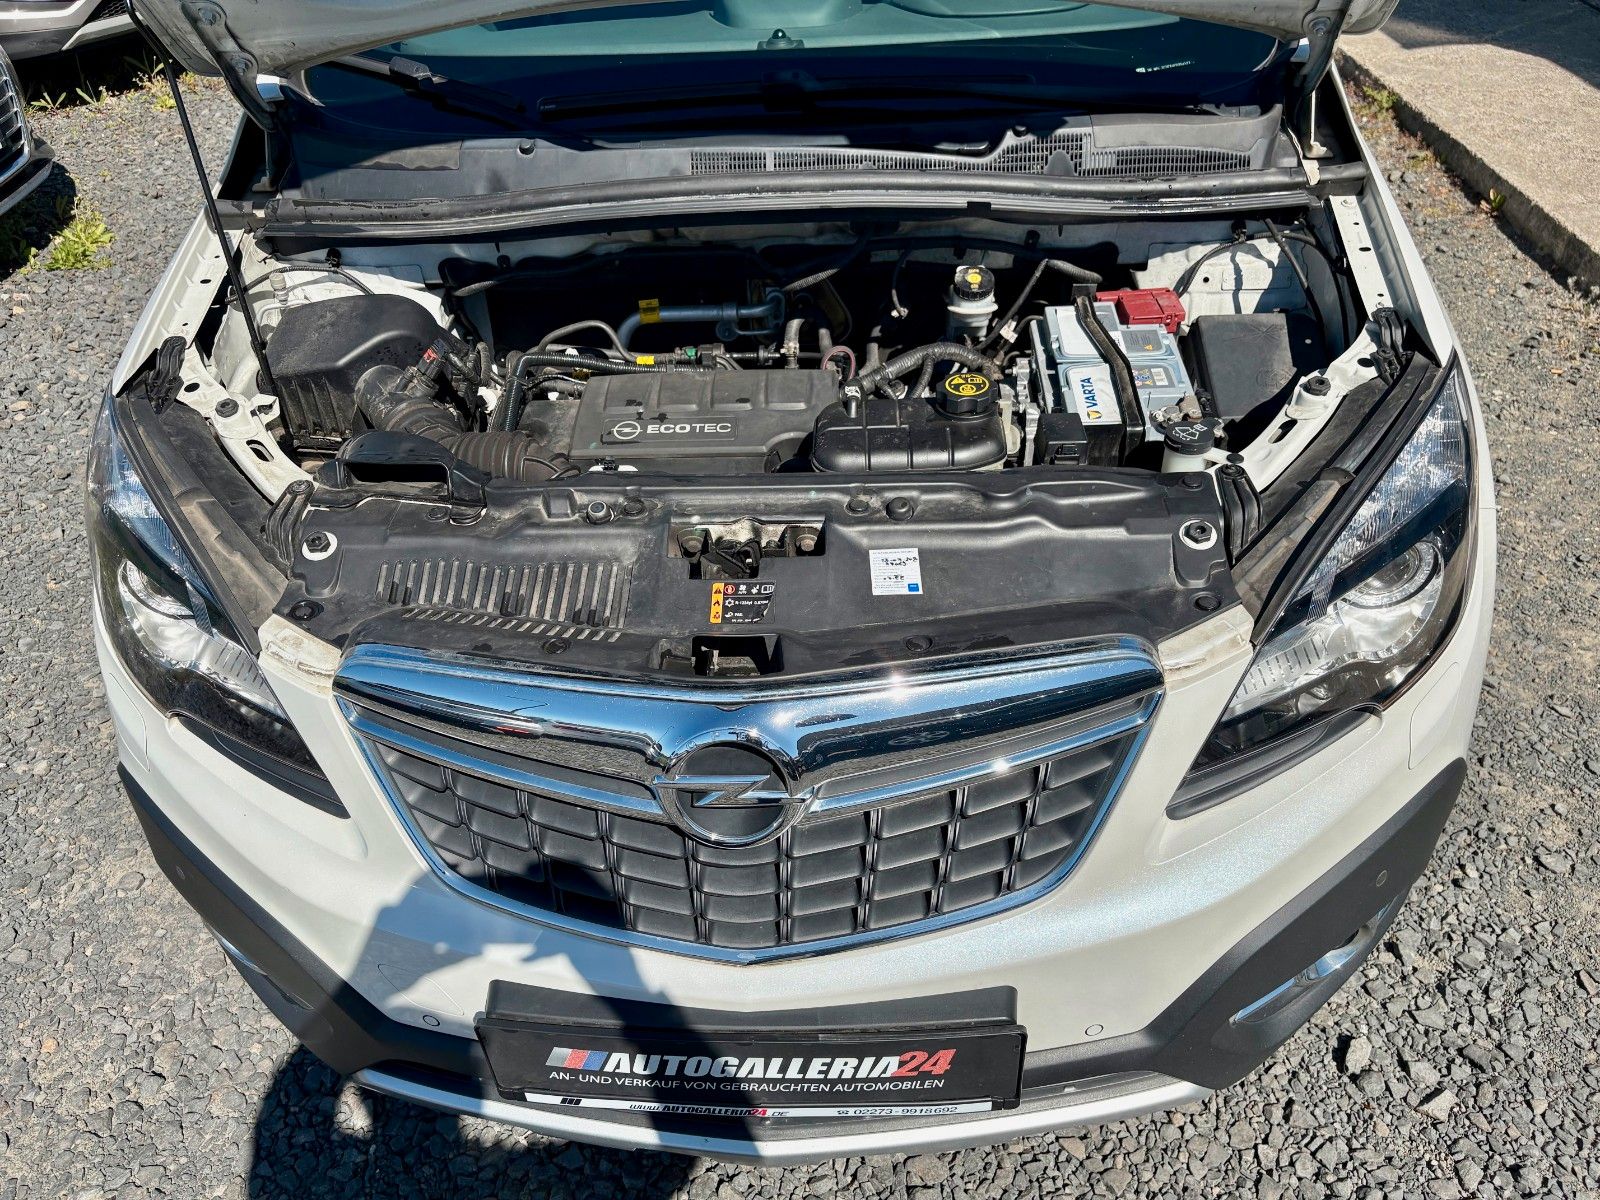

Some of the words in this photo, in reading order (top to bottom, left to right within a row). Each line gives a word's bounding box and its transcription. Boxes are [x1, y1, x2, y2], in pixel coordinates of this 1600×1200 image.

[1080, 376, 1098, 409] VARTA
[647, 423, 732, 434] ECOTEC
[603, 1049, 956, 1078] AUTOGALLERIA24
[550, 1071, 575, 1082] AN-
[579, 1074, 612, 1085] UND
[615, 1077, 680, 1090] VERKAUF
[684, 1081, 716, 1091] VON
[720, 1081, 831, 1092] GEBRAUCHTEN
[833, 1079, 945, 1092] AUTOMOBILEN
